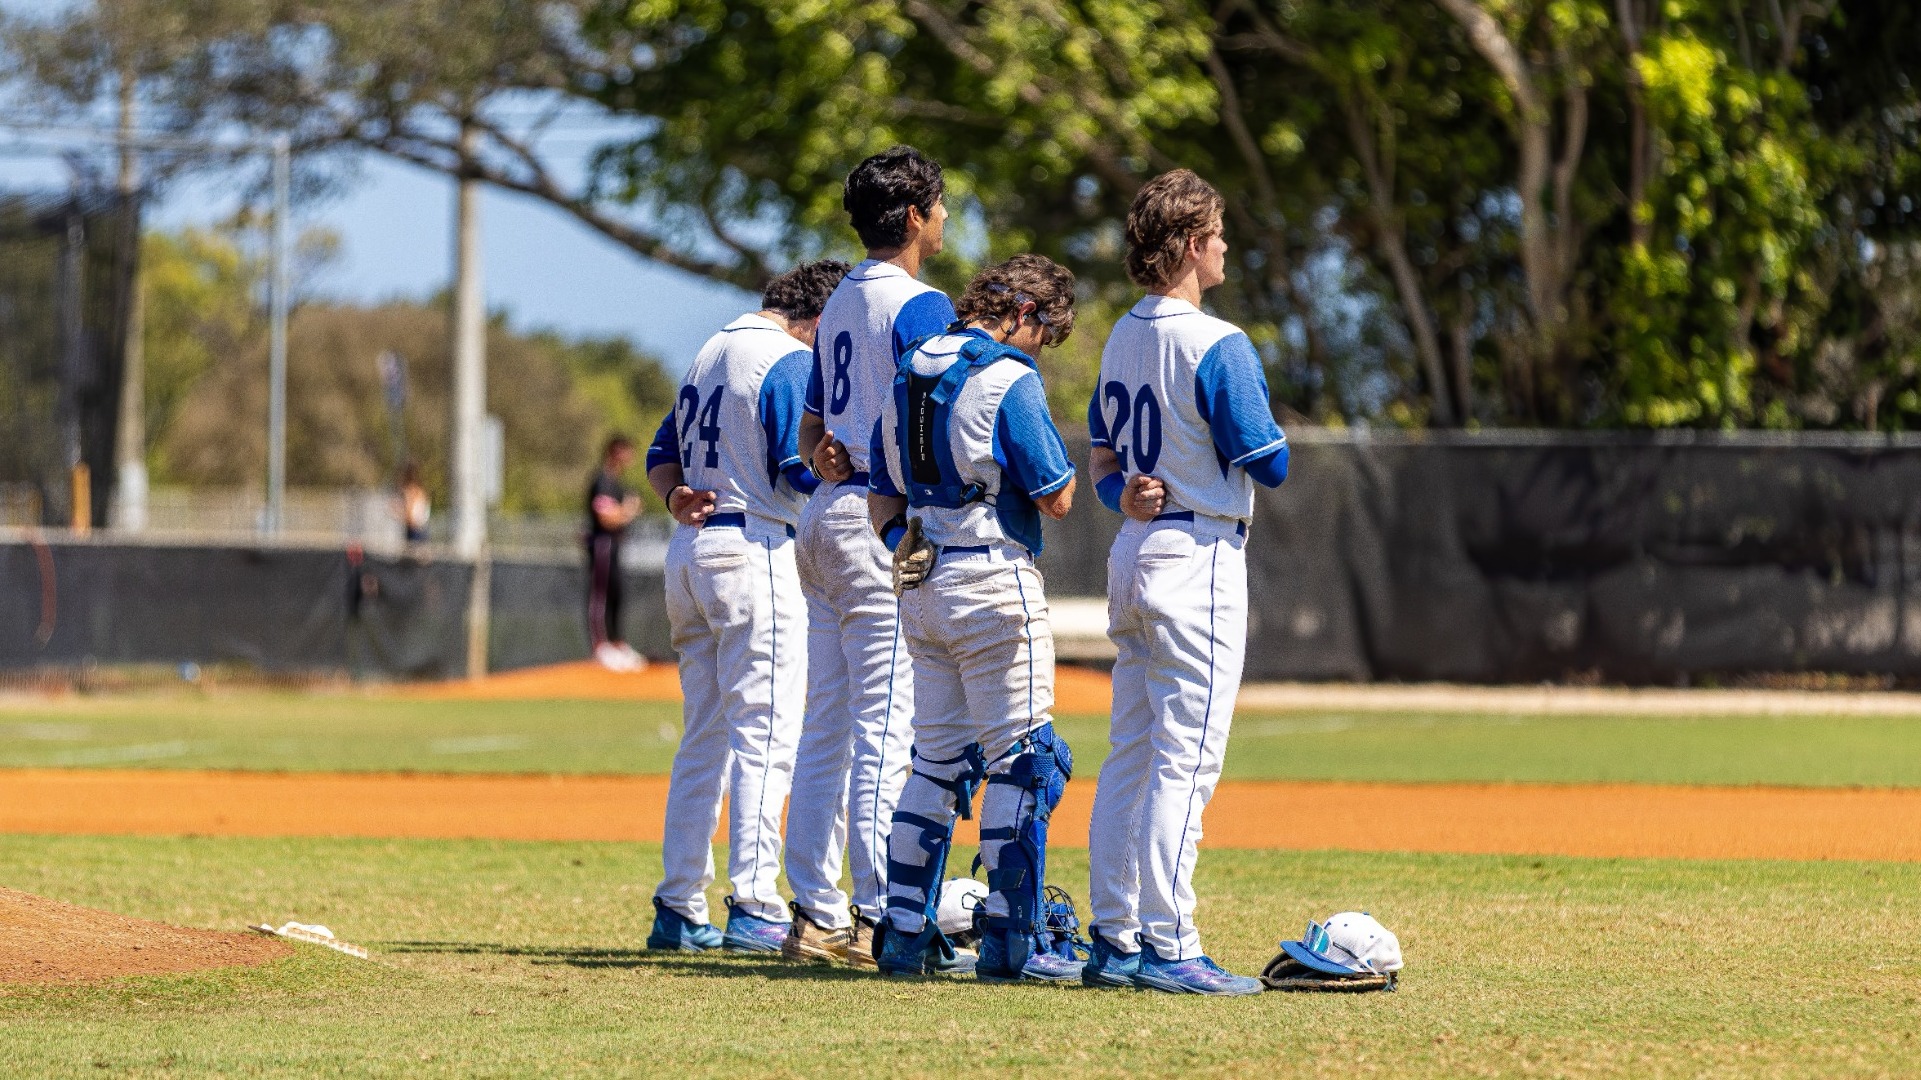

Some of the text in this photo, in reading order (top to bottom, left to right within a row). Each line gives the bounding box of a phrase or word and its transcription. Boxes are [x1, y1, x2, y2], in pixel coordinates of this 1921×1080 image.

[830, 331, 853, 415] 8
[679, 384, 724, 468] 24
[1104, 381, 1163, 474] 20
